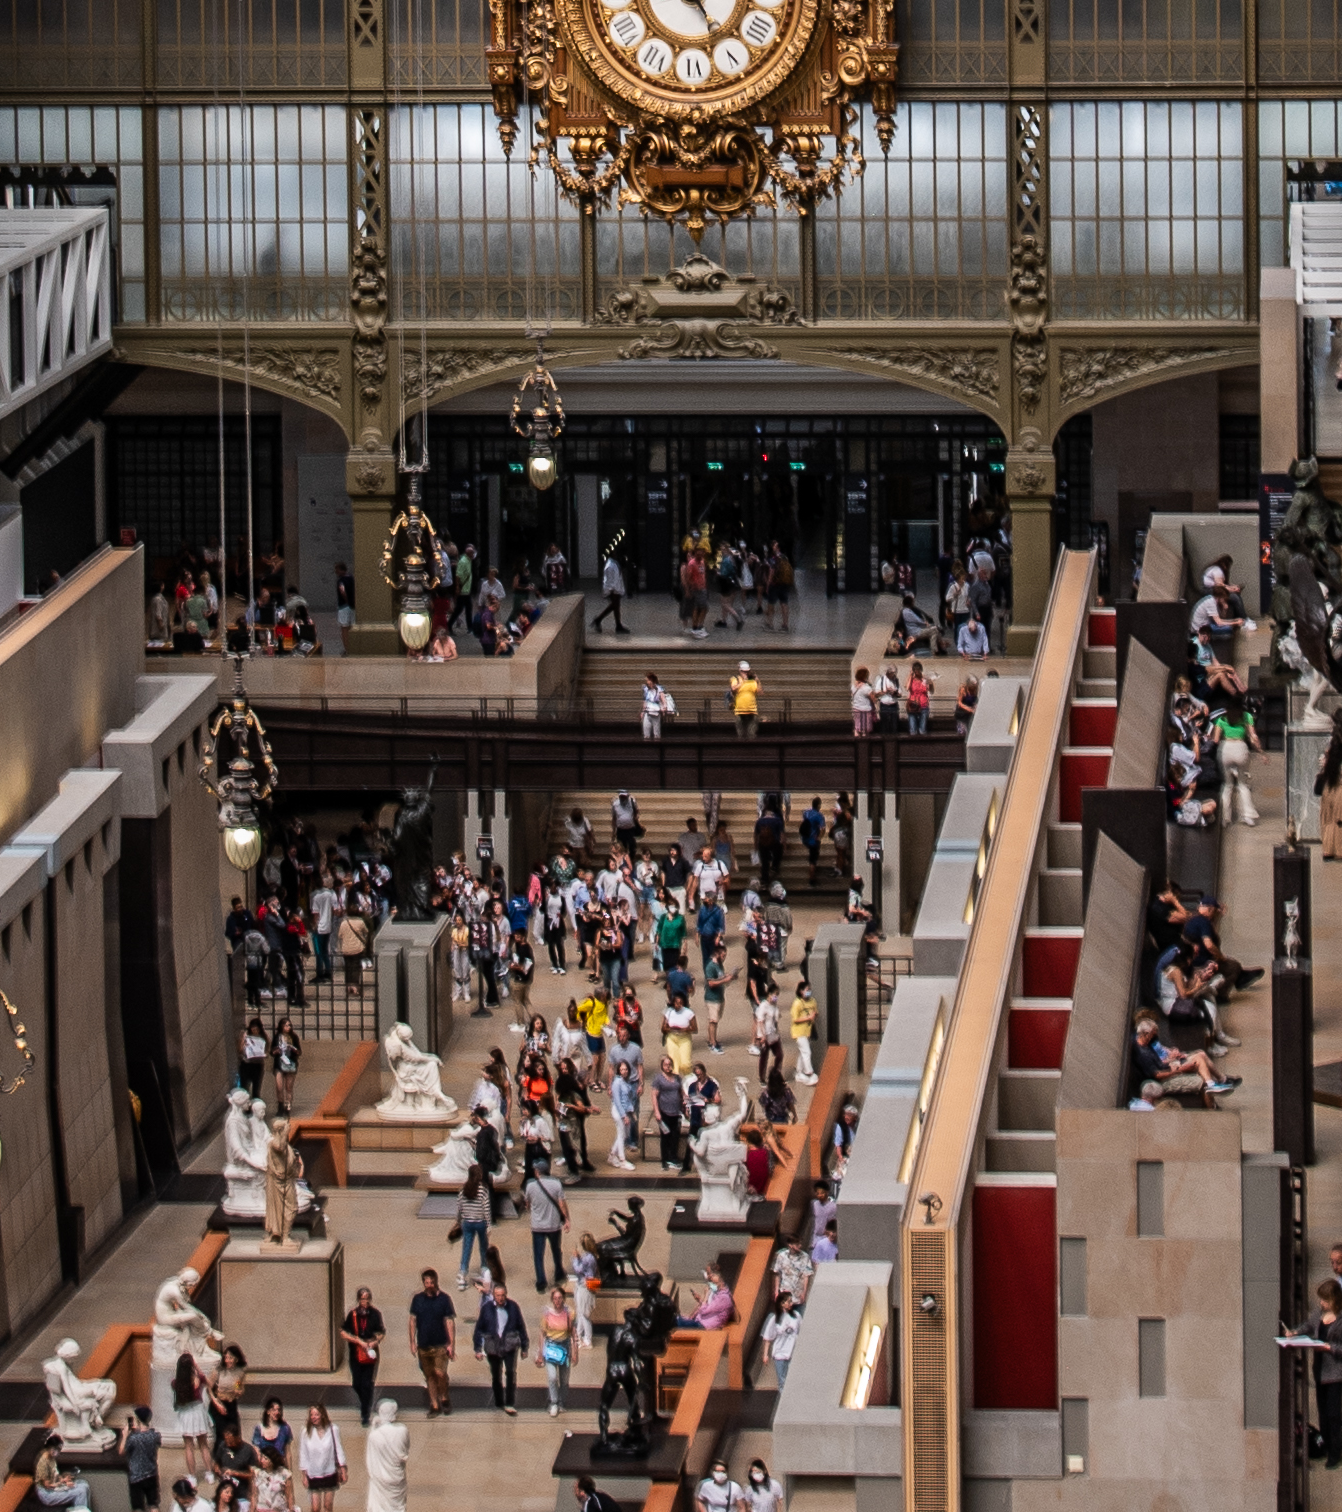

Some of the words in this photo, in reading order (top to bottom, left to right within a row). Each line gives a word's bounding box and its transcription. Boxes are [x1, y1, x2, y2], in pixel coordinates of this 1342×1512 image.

[613, 14, 640, 47] VIII
[746, 15, 772, 44] IIII
[643, 45, 666, 73] VII
[686, 56, 703, 78] VI
[725, 48, 740, 69] V
